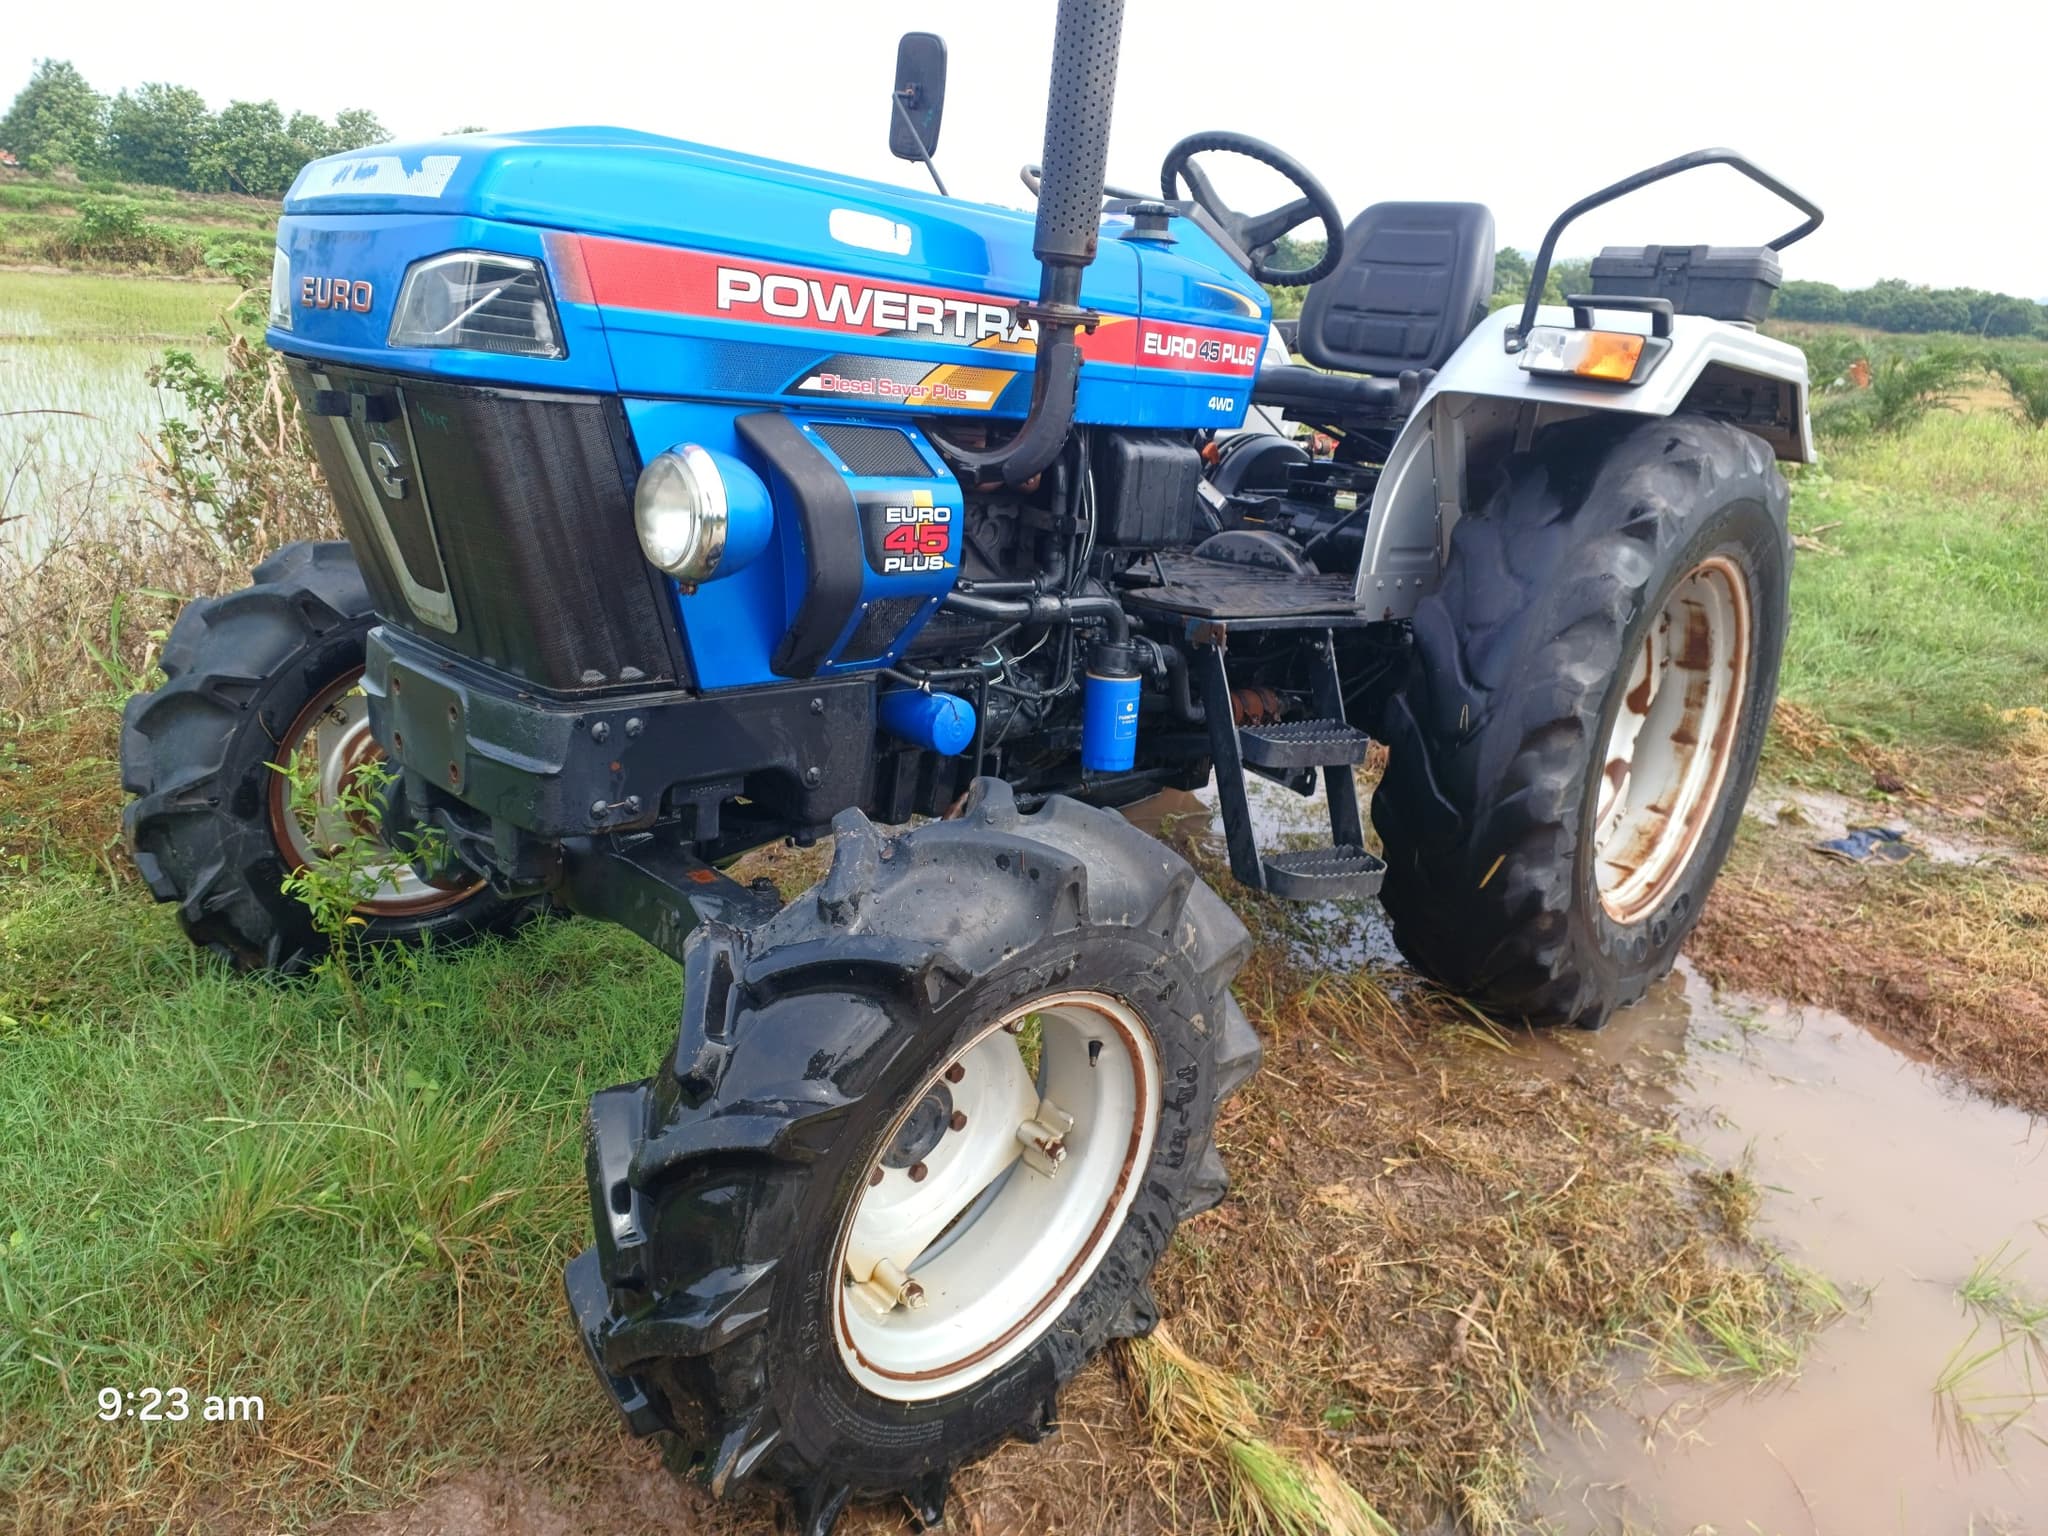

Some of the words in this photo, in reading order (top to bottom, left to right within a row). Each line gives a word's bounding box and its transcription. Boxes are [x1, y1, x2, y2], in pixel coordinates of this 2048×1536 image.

[302, 276, 373, 312] EURO
[1144, 332, 1197, 359] EURO
[1198, 340, 1221, 362] 45
[1222, 343, 1256, 366] PLUS
[820, 373, 876, 394] Diesel
[879, 379, 929, 397] Saver
[932, 384, 967, 400] Plus
[1208, 396, 1234, 411] 4WD
[886, 507, 951, 522] EURO
[884, 525, 949, 554] 45
[884, 556, 944, 572] PLUS
